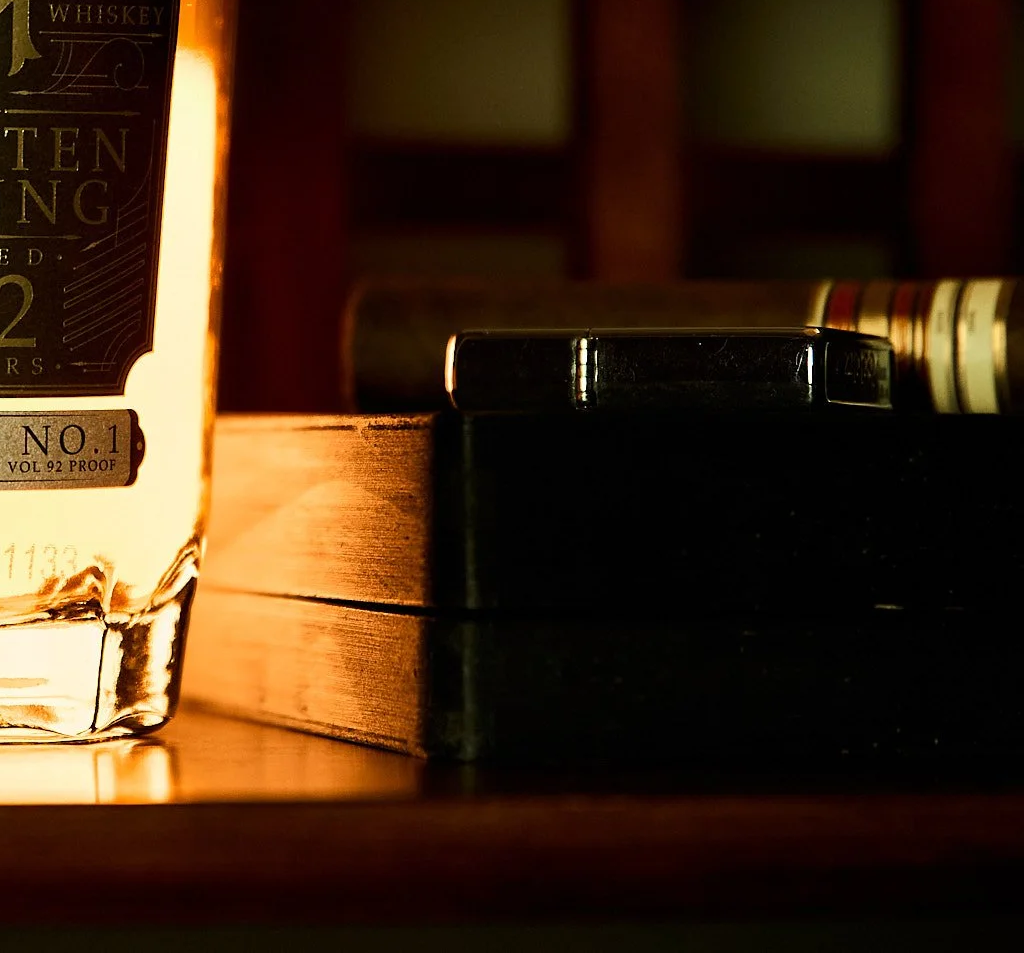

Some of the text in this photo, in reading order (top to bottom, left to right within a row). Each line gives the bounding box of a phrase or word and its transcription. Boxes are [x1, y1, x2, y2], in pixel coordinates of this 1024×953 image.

[49, 3, 165, 26] WHISKEY
[8, 461, 40, 473] VOL
[47, 460, 63, 473] 92
[69, 459, 116, 472] PROOF
